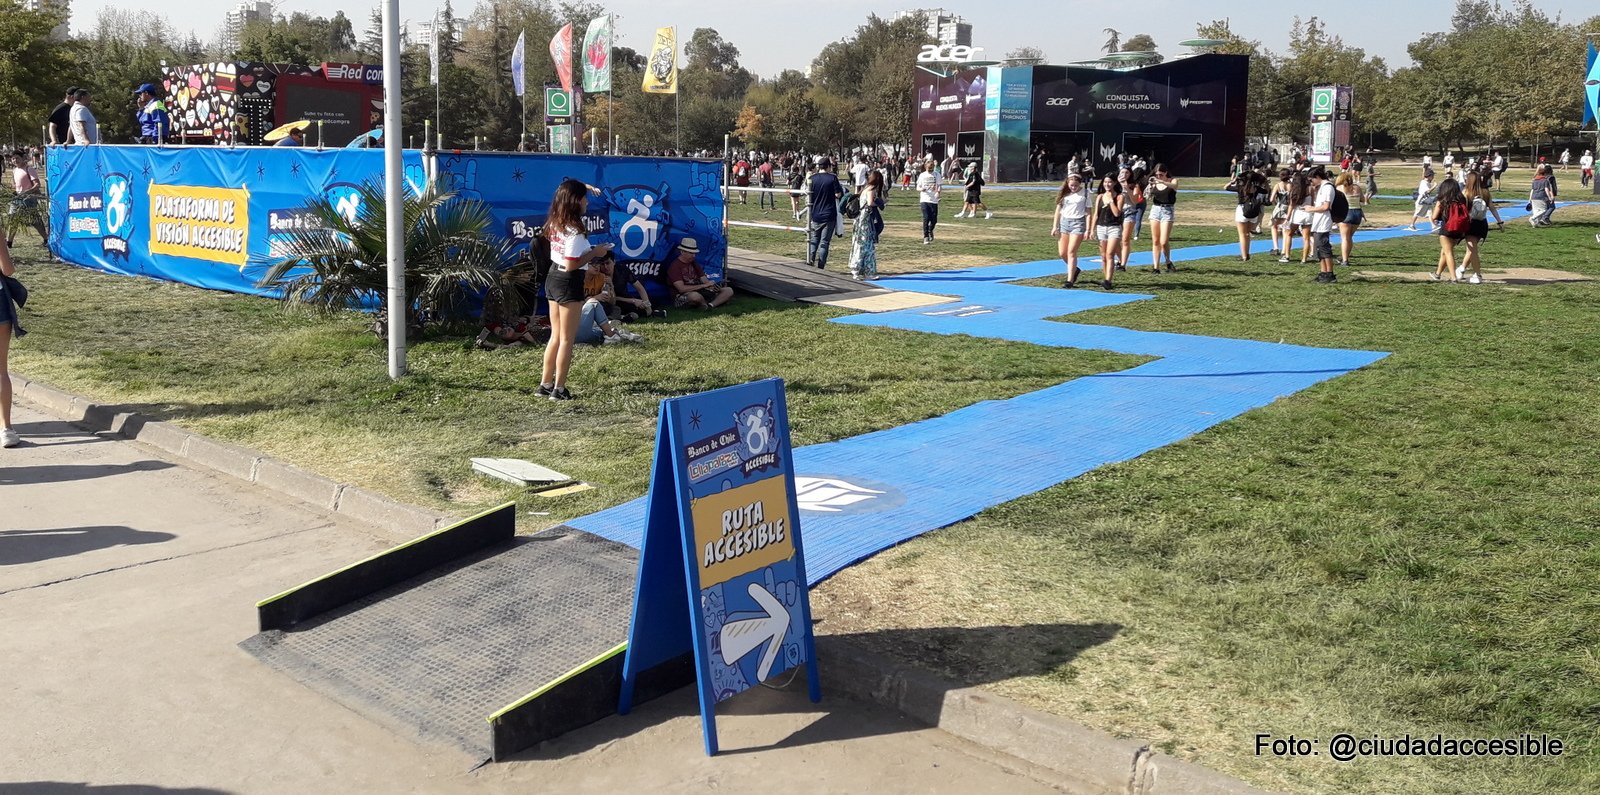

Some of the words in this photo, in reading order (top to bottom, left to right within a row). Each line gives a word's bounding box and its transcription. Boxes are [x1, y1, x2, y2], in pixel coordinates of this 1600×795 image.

[916, 44, 984, 62] acer
[340, 64, 363, 79] Red
[1046, 97, 1074, 106] acer
[1106, 94, 1149, 102] CONQUISTA
[155, 195, 220, 222] PLATAFORMA
[222, 200, 235, 224] DE
[269, 212, 292, 230] Banco
[156, 221, 190, 246] VISIÓN
[192, 225, 243, 253] ACCESIBLE
[627, 262, 660, 276] ESIBLE
[688, 445, 710, 458] Banco
[711, 440, 718, 449] de
[719, 433, 736, 446] Chile
[745, 454, 775, 472] ACCESIBLE
[721, 501, 765, 537] RUTA
[703, 518, 785, 568] ACCESIBLE
